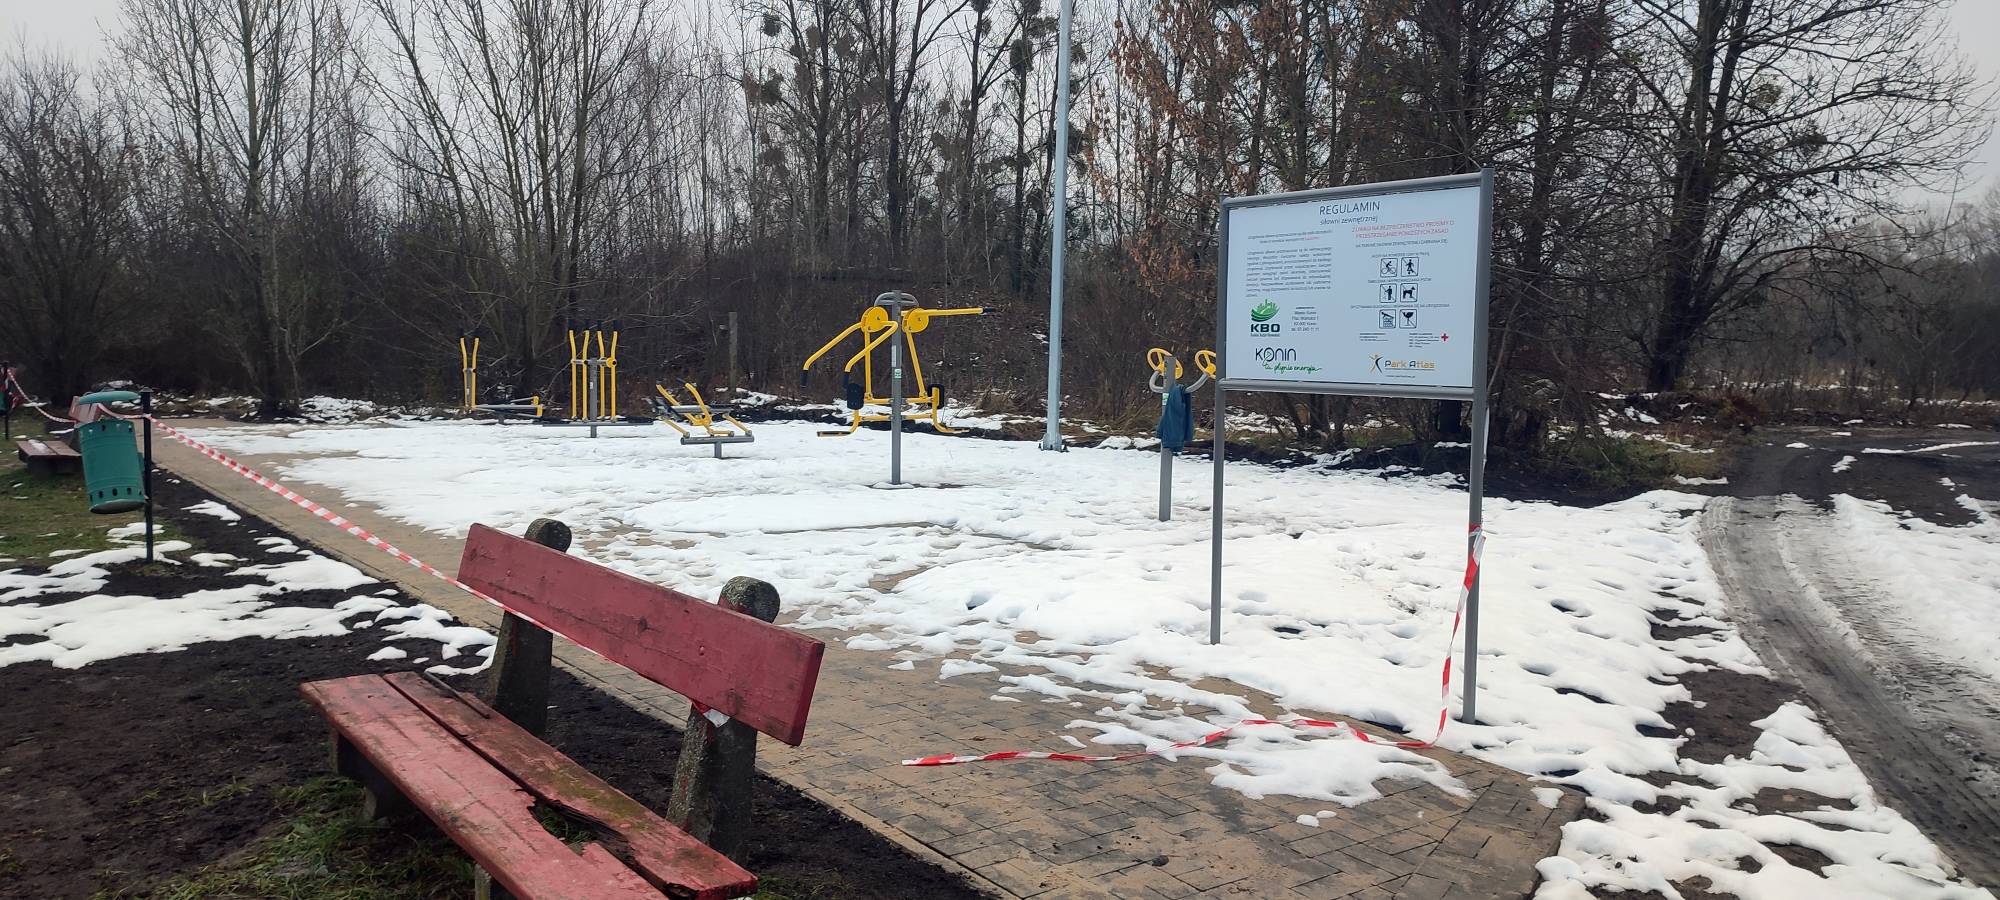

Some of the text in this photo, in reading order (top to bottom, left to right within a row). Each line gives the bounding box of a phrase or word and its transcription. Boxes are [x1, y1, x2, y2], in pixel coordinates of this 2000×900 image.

[1319, 201, 1381, 216] REGULAMIN
[1341, 215, 1378, 226] zewnętrznej
[1250, 323, 1281, 333] KBO
[1385, 360, 1435, 369] Park Atlas
